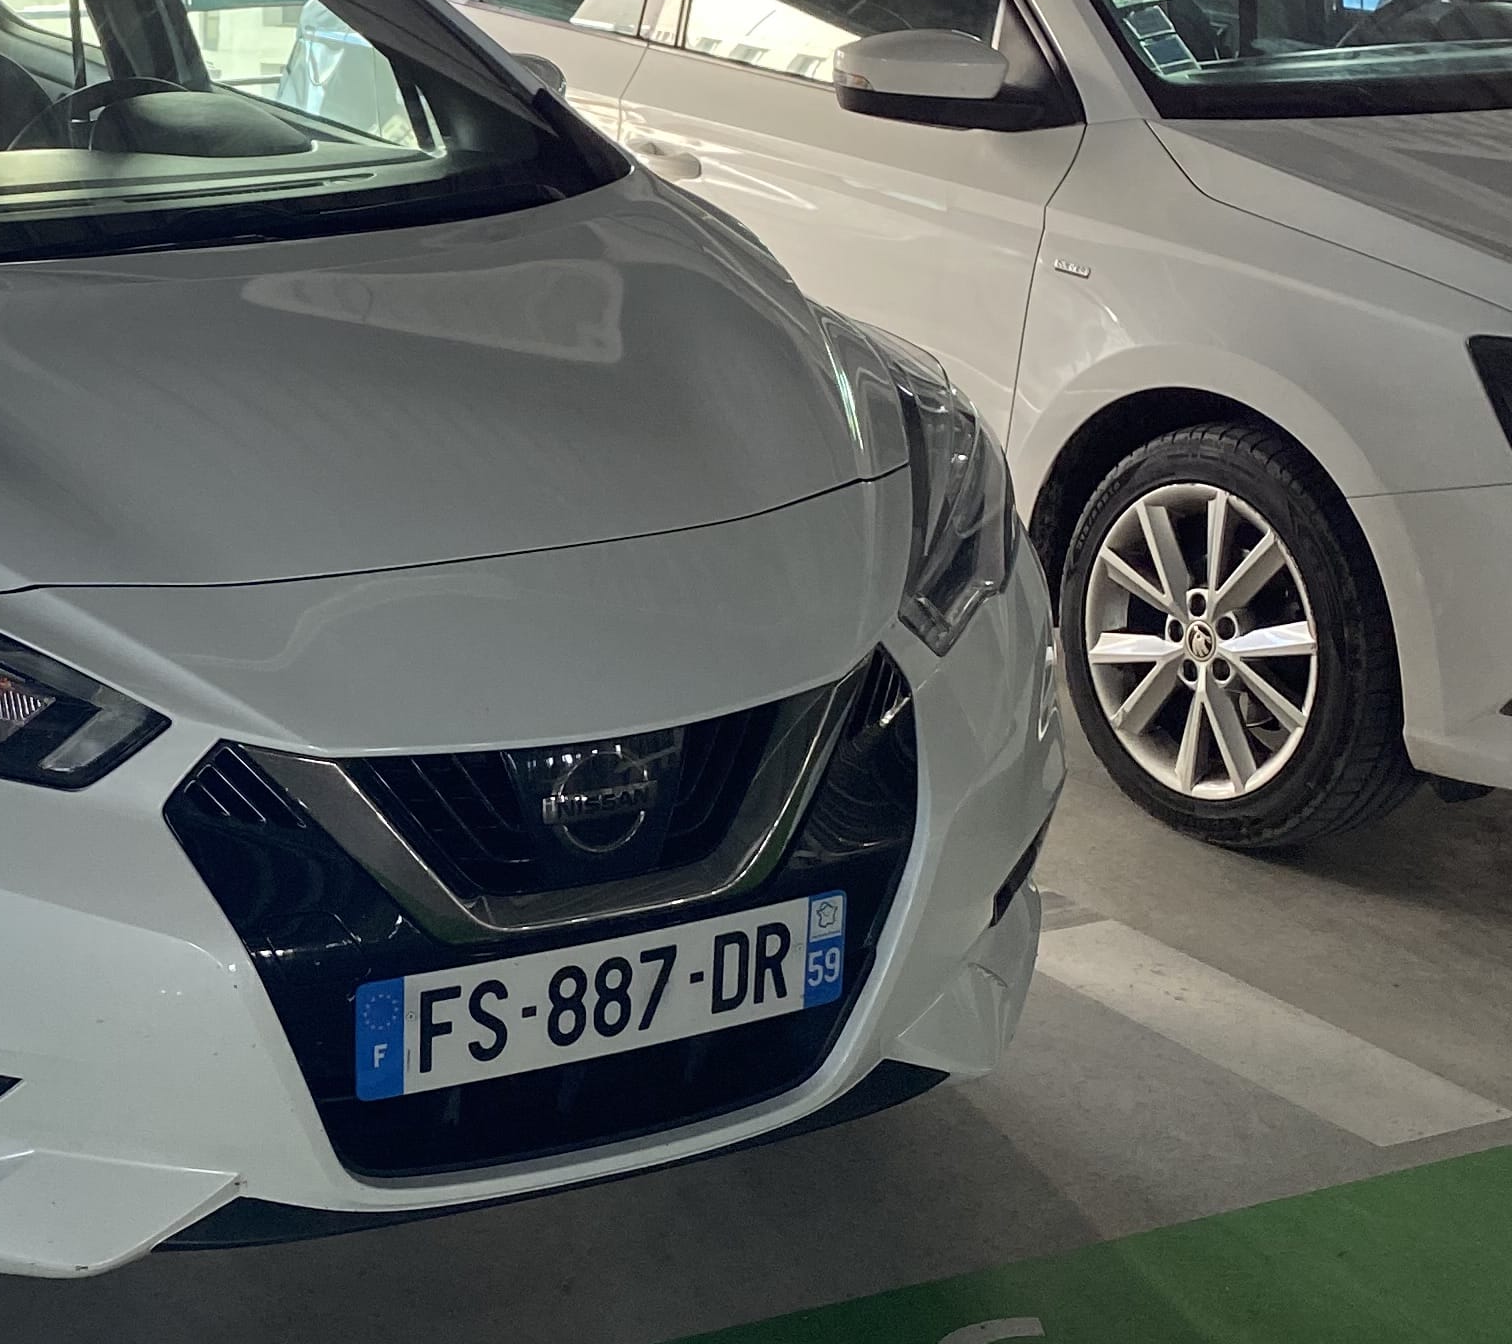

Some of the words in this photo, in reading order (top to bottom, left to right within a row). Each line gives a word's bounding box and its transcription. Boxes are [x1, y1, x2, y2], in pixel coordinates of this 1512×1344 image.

[807, 946, 841, 987] 59
[418, 921, 791, 1074] FS-887-DR
[374, 1043, 387, 1069] F
